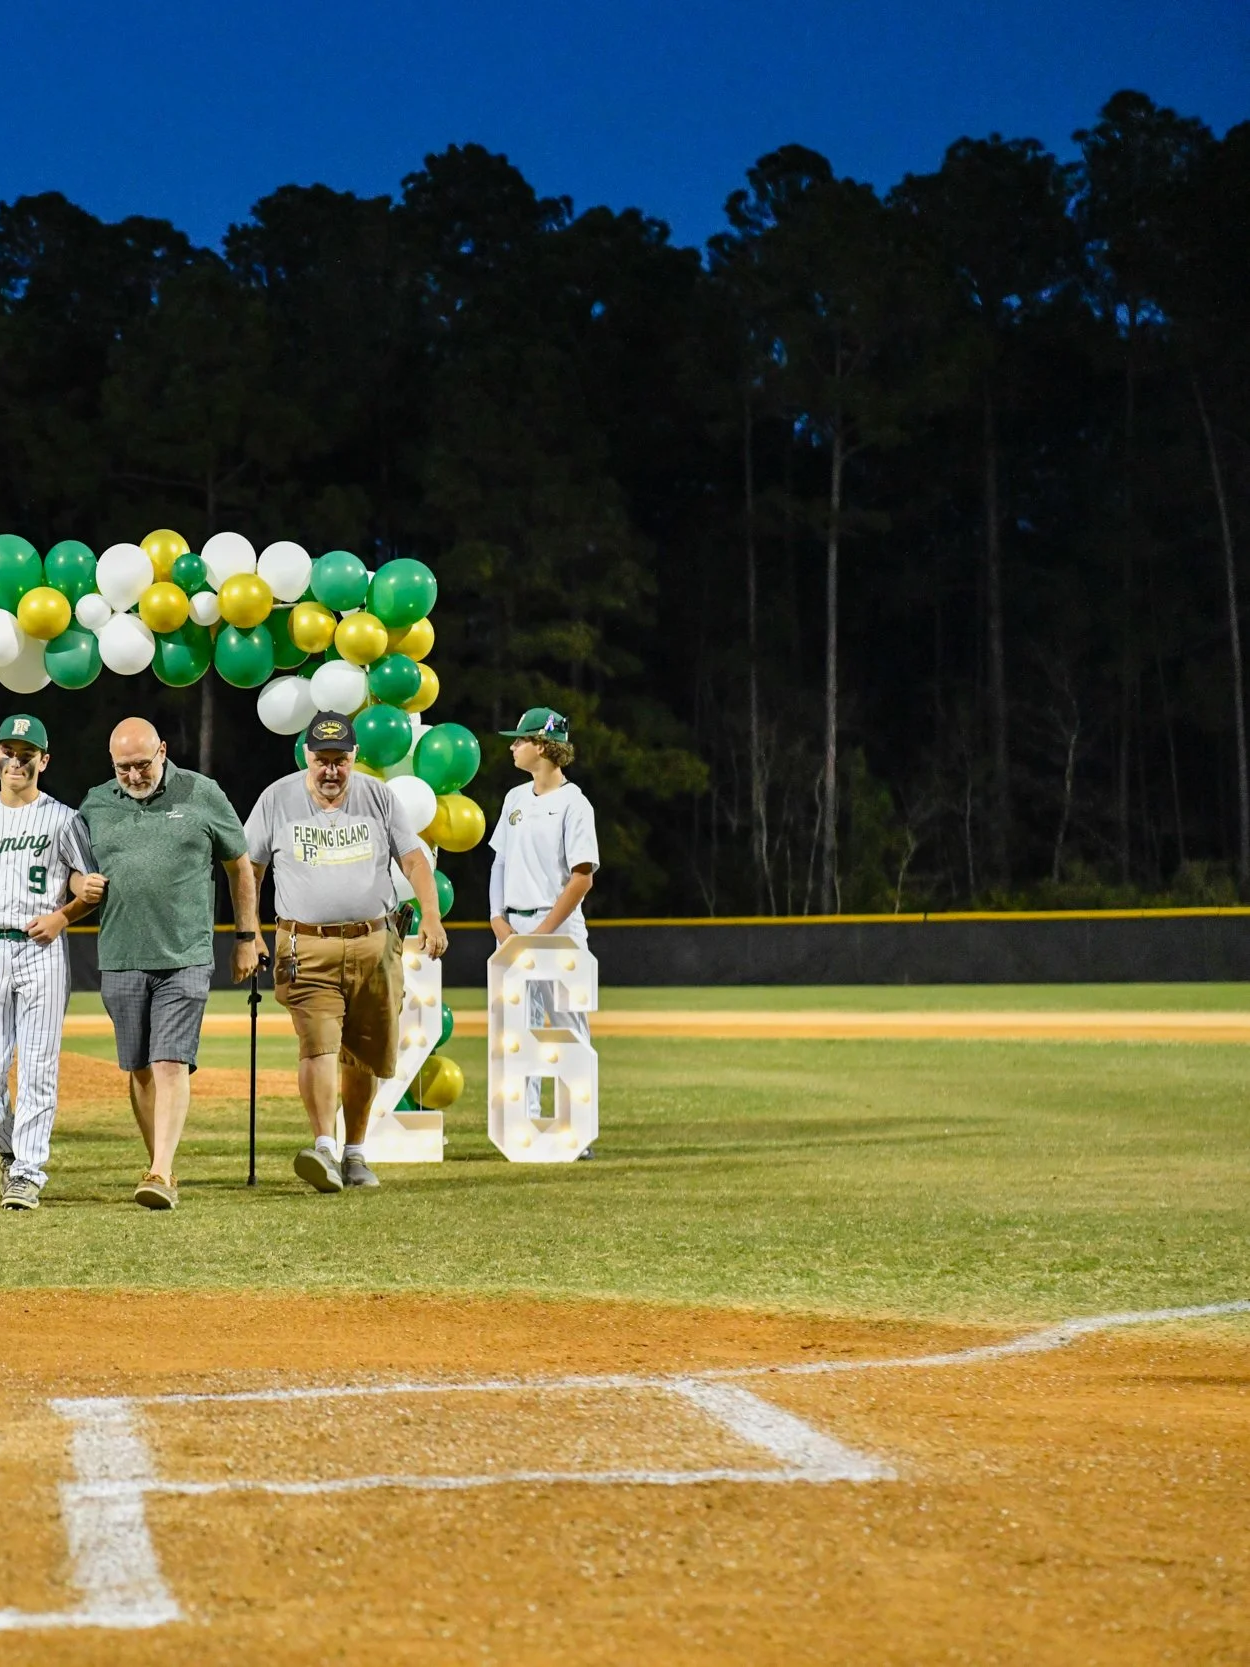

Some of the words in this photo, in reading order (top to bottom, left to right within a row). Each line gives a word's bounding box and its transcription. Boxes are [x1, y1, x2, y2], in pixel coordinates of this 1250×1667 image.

[293, 825, 334, 847] FLEMING
[336, 824, 369, 847] ISLAND
[29, 866, 47, 894] 9
